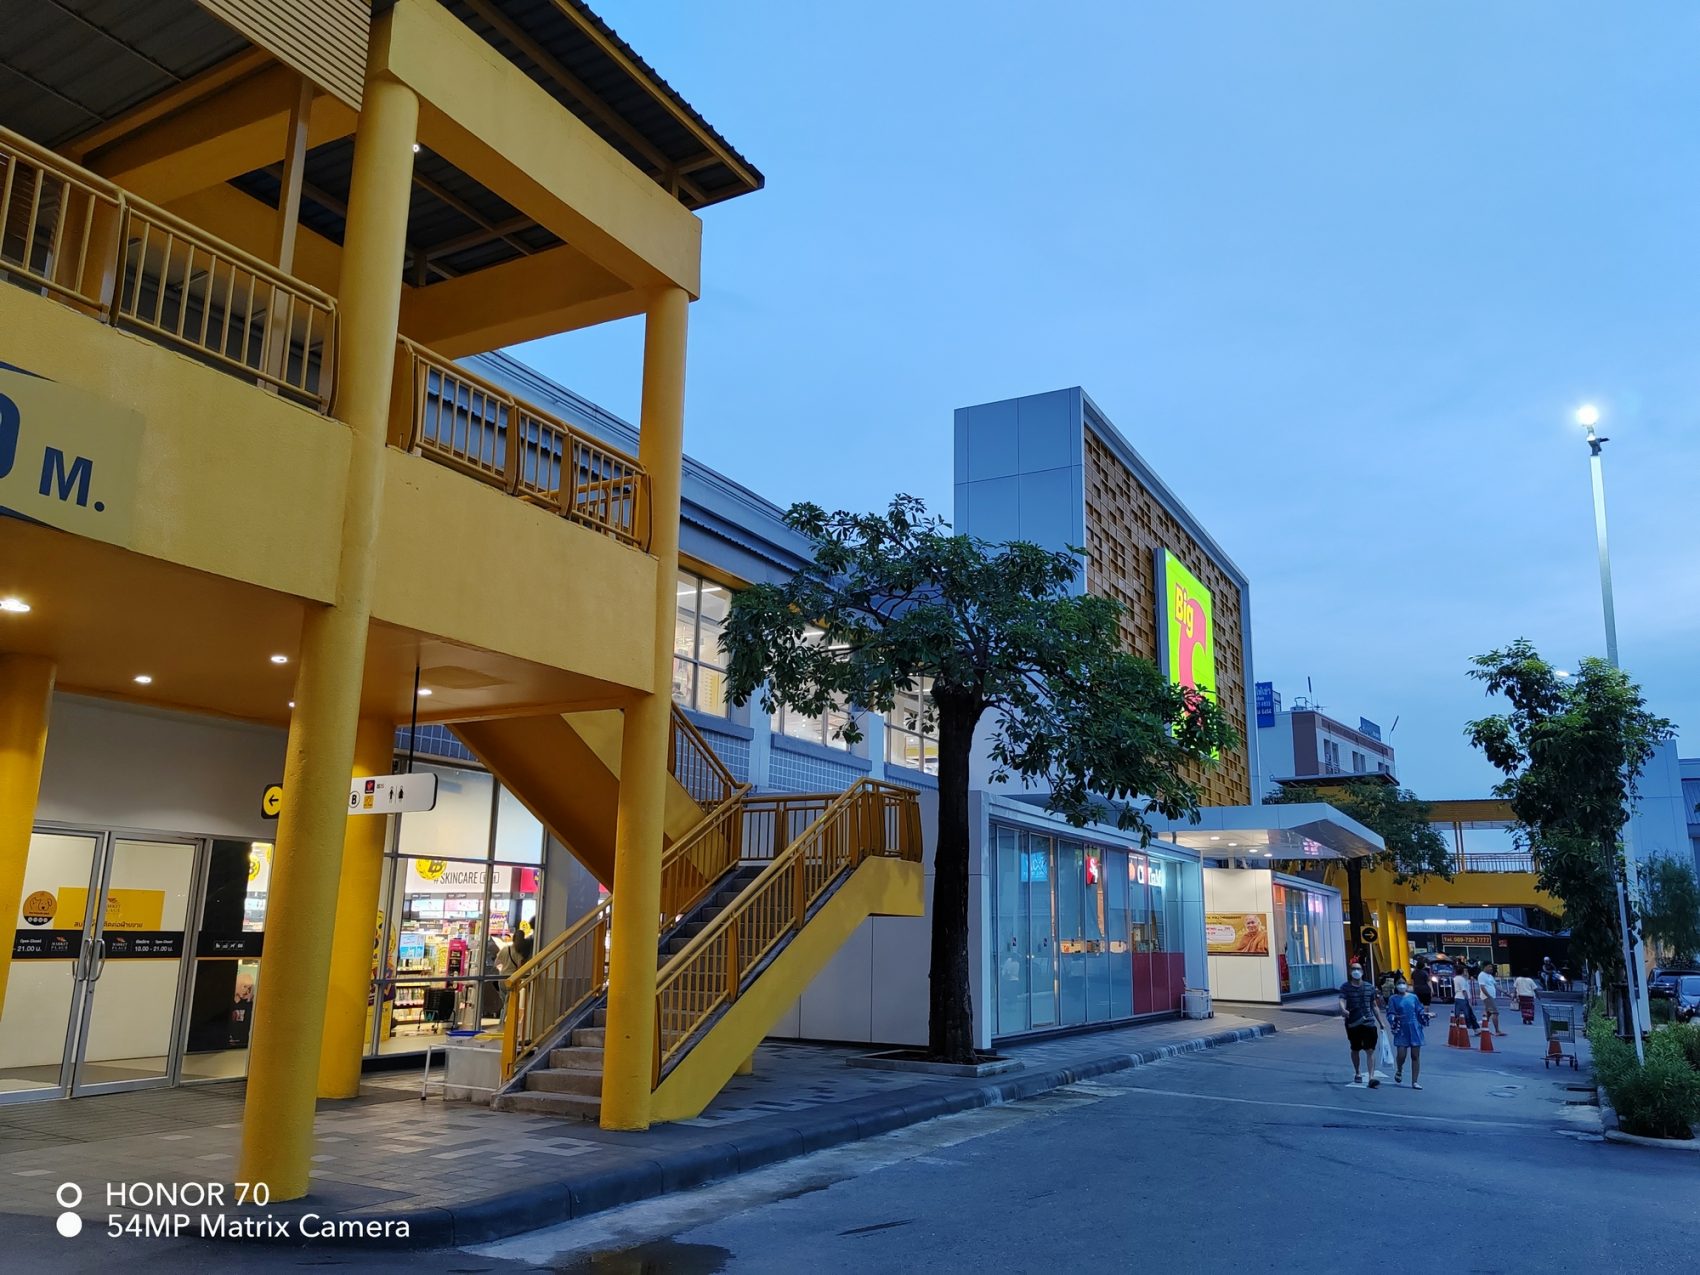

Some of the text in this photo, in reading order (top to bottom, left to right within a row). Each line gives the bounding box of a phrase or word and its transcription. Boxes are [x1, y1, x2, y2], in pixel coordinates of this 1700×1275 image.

[38, 445, 105, 512] M.
[1175, 583, 1194, 639] Big
[351, 794, 358, 805] B
